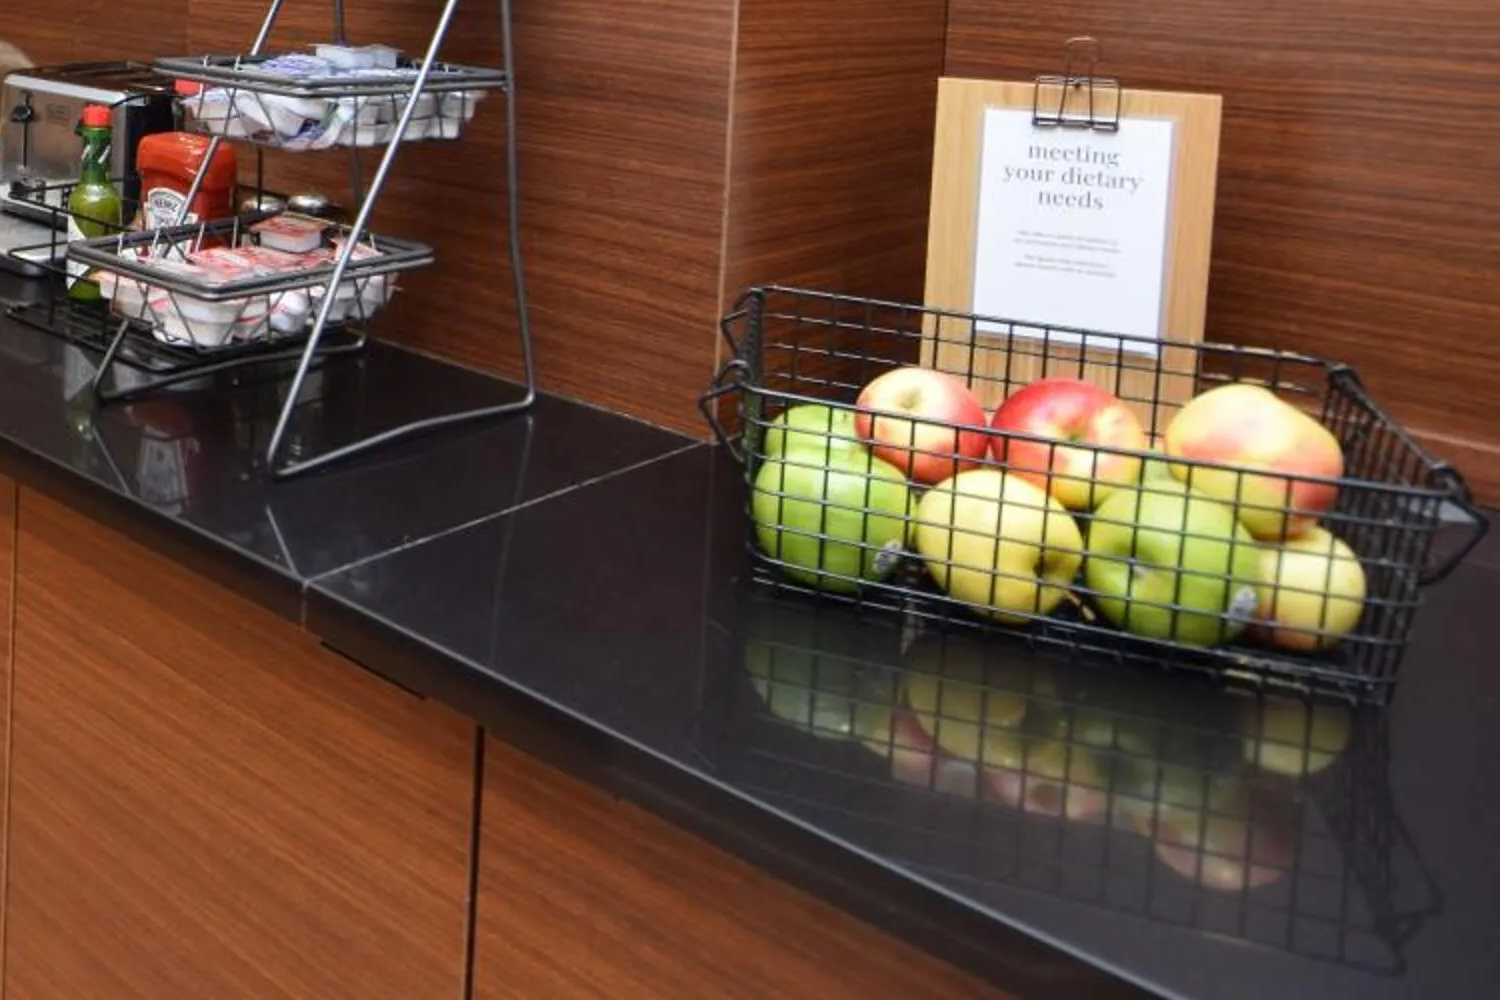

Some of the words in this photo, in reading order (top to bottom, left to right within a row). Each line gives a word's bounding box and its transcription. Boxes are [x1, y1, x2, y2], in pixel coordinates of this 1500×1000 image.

[1028, 144, 1120, 166] meeting
[1003, 166, 1055, 183] your
[1061, 167, 1143, 194] dietary
[1038, 189, 1104, 210] needs
